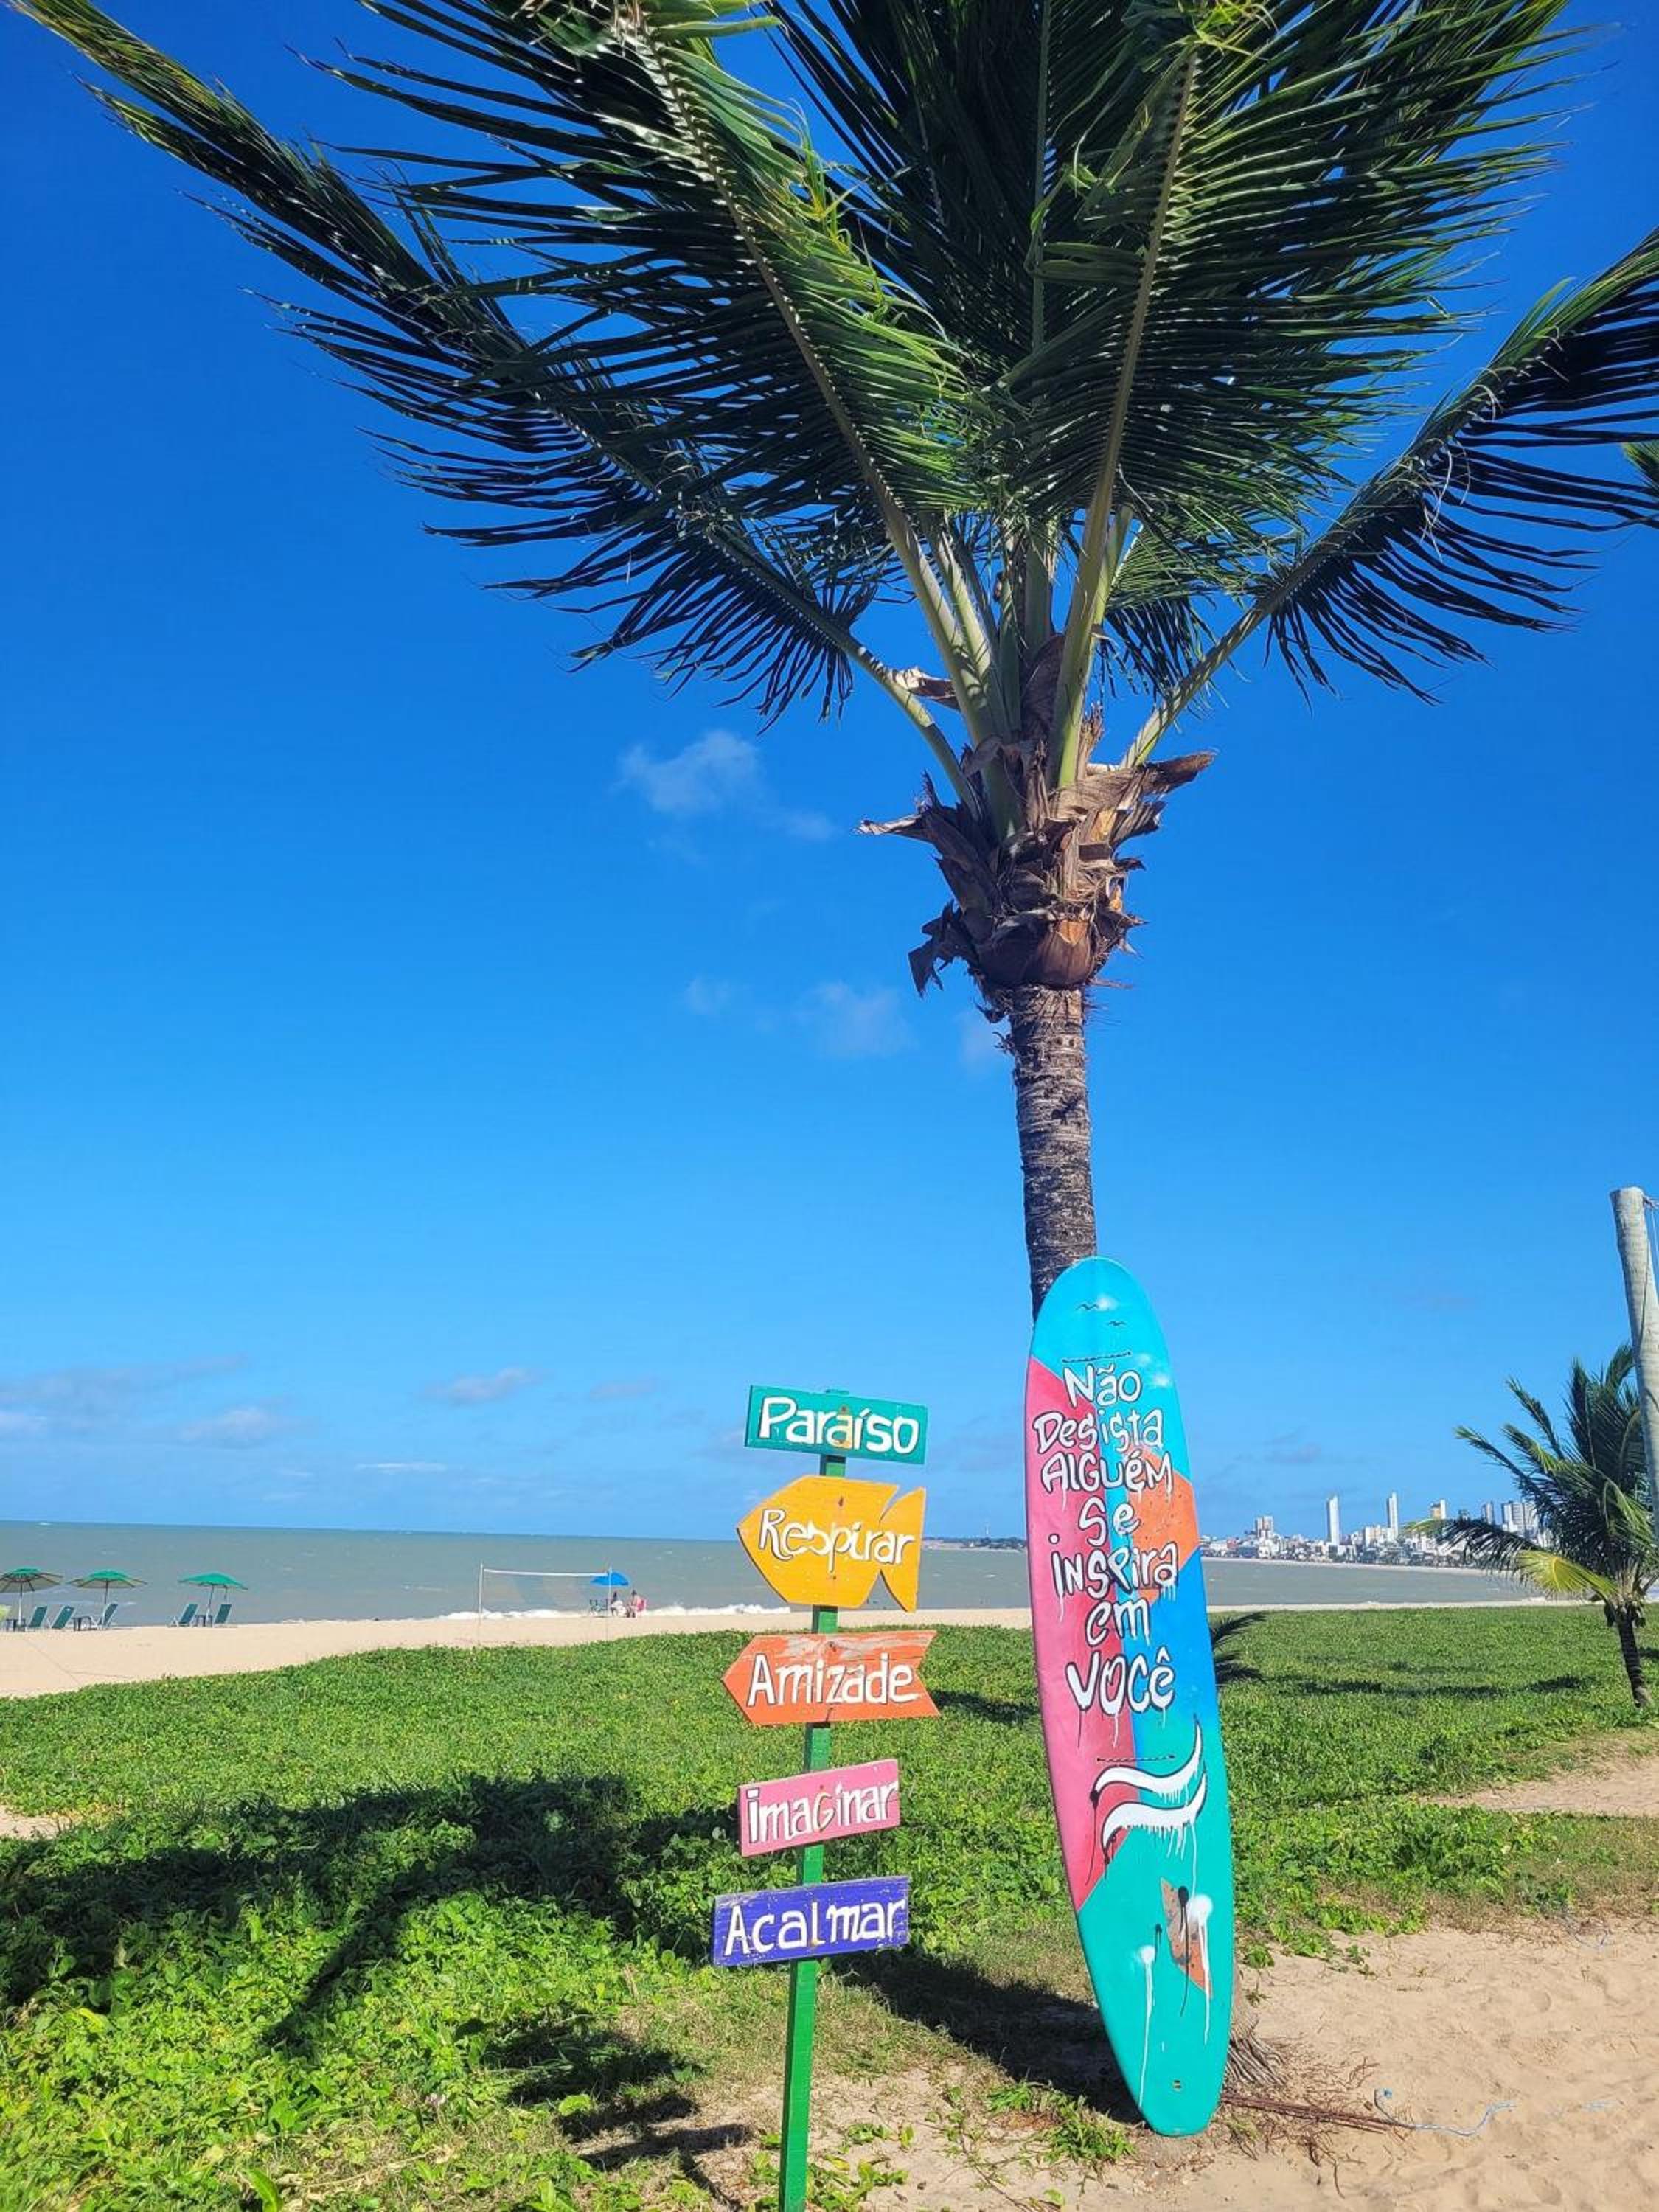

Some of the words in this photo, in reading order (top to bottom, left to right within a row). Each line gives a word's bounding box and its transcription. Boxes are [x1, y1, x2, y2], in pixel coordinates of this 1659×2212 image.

[1062, 1363, 1142, 1407] Não
[759, 1396, 919, 1453] Paraíso
[1033, 1408, 1164, 1454] Desista
[759, 1509, 916, 1573] Respirar
[1086, 1597, 1152, 1647] em
[746, 1653, 919, 1708] Amizade
[723, 1899, 907, 1957] Acalmar
